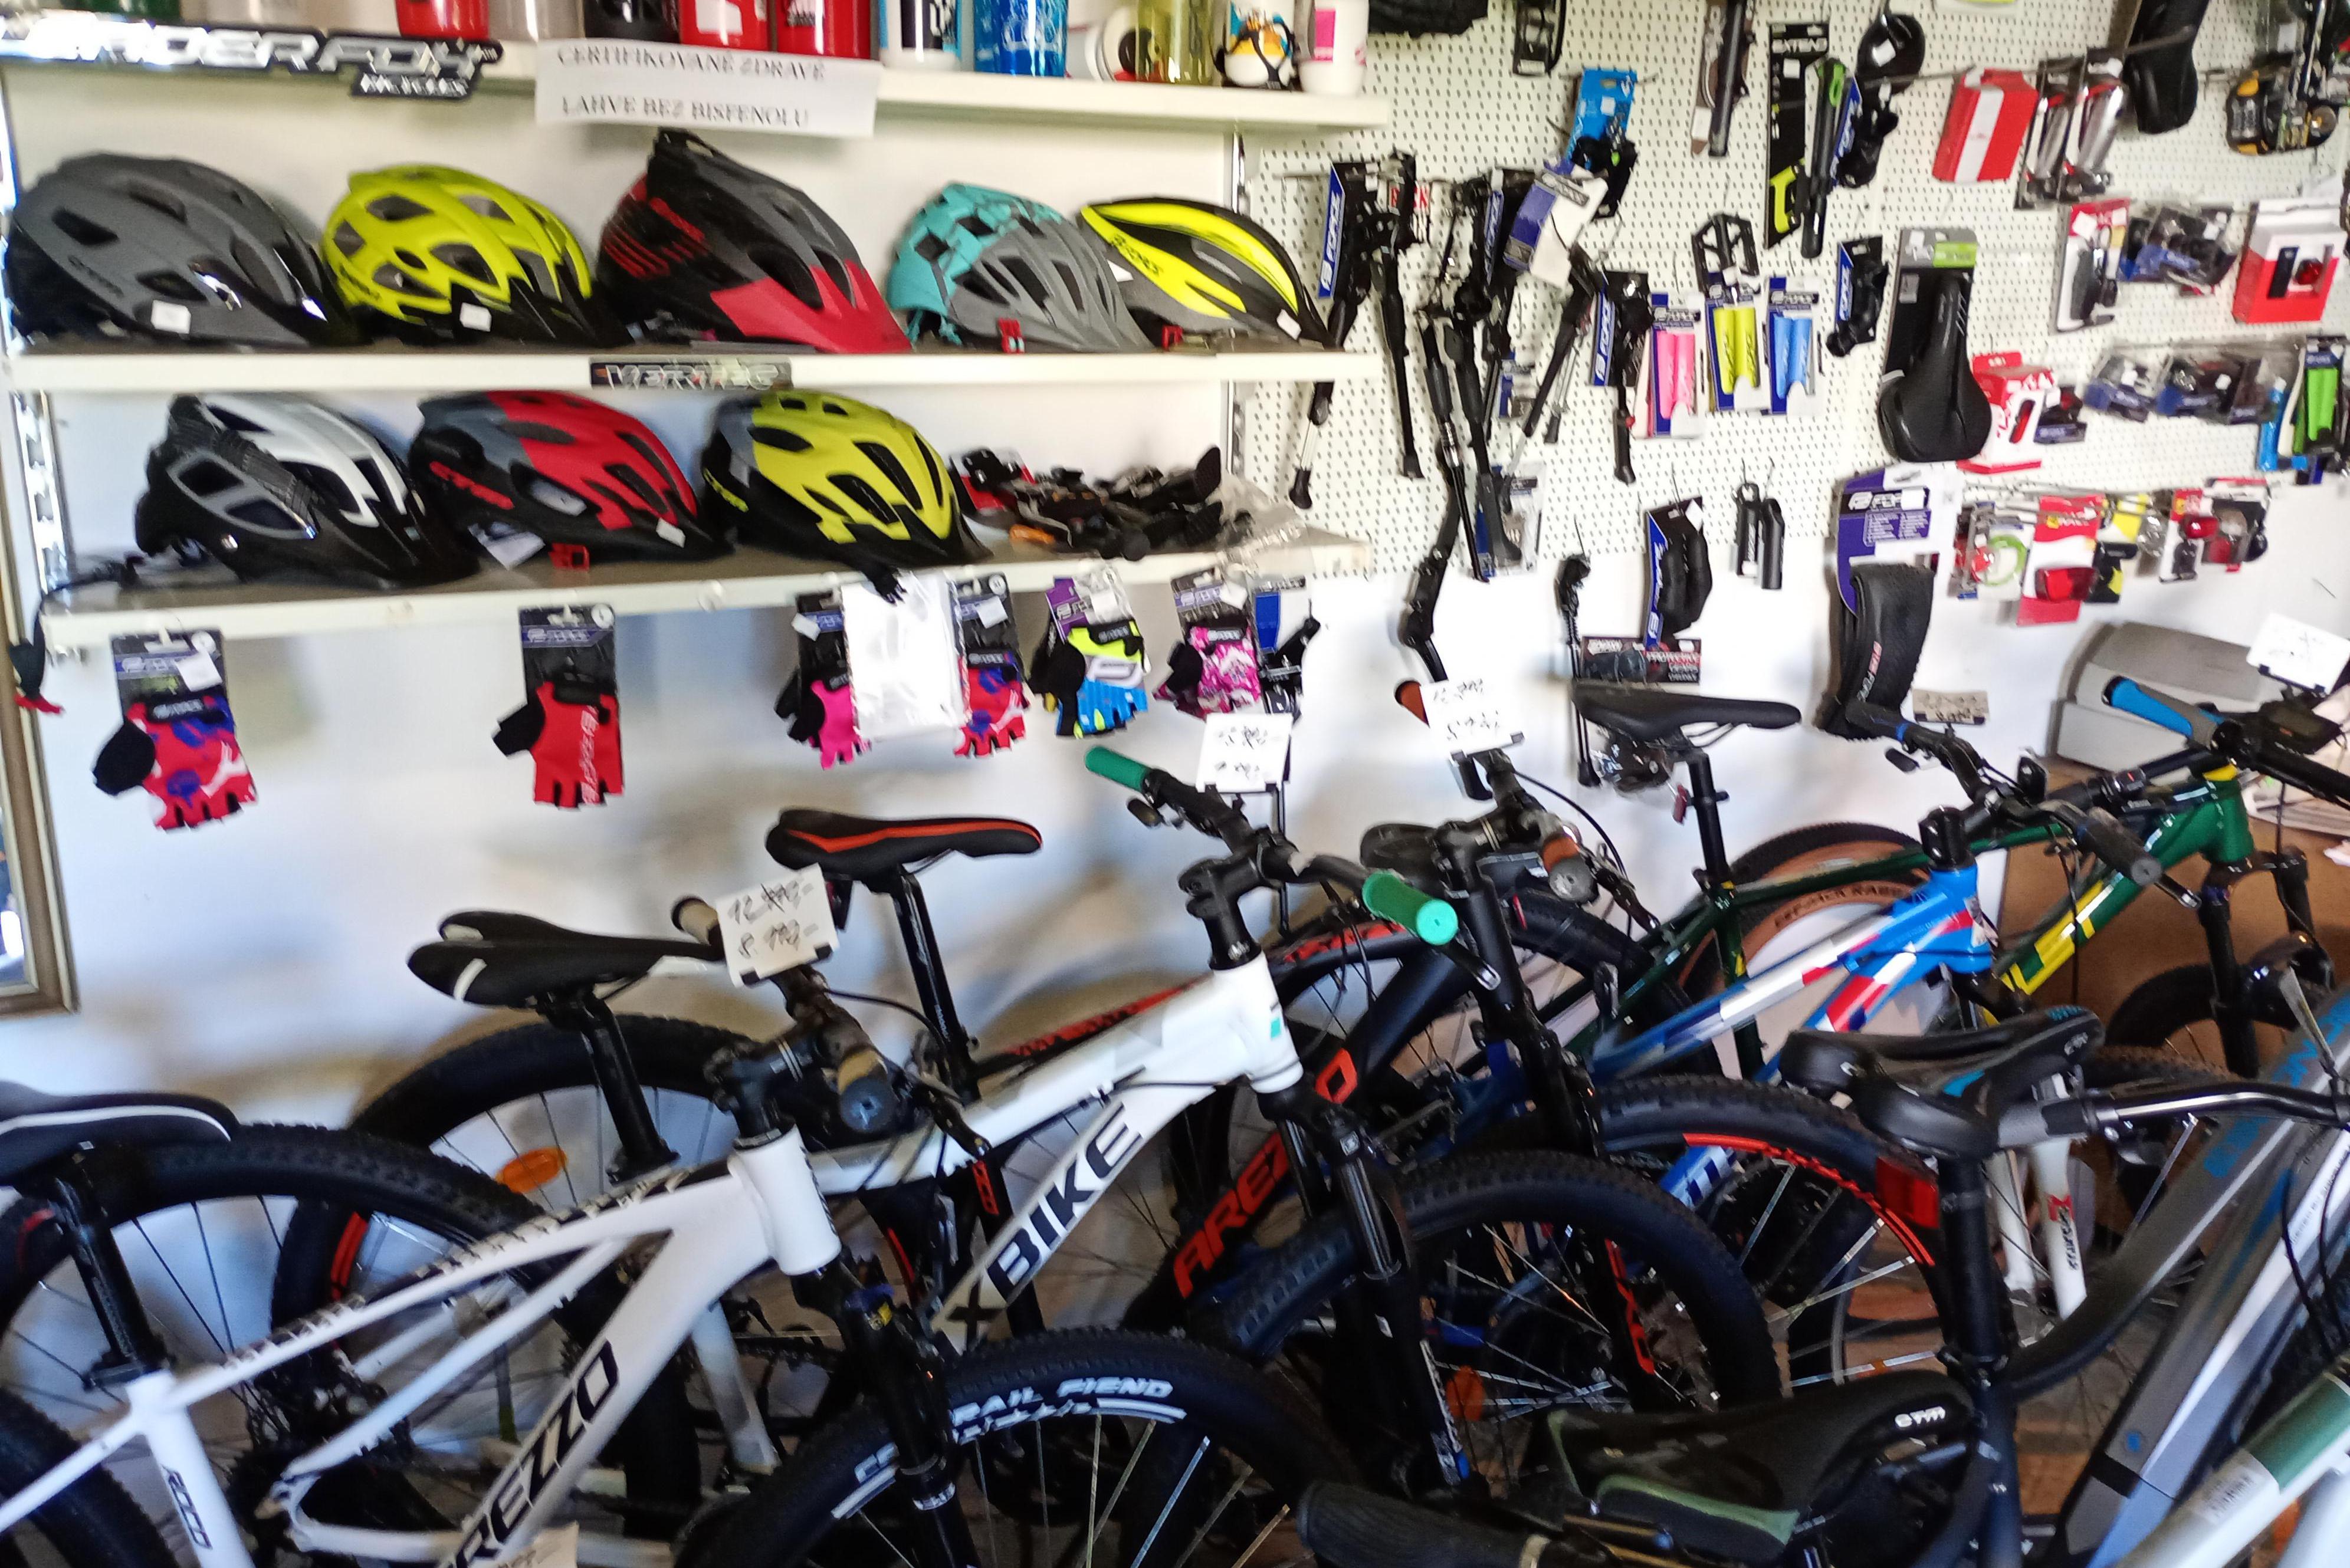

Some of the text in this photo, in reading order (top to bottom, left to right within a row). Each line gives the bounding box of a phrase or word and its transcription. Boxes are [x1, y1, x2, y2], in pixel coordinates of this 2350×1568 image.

[643, 97, 684, 117] BEZ
[932, 1101, 1143, 1357] XBIKE
[444, 1337, 619, 1568] REZZO
[946, 1376, 1174, 1427] RAIL FIEND
